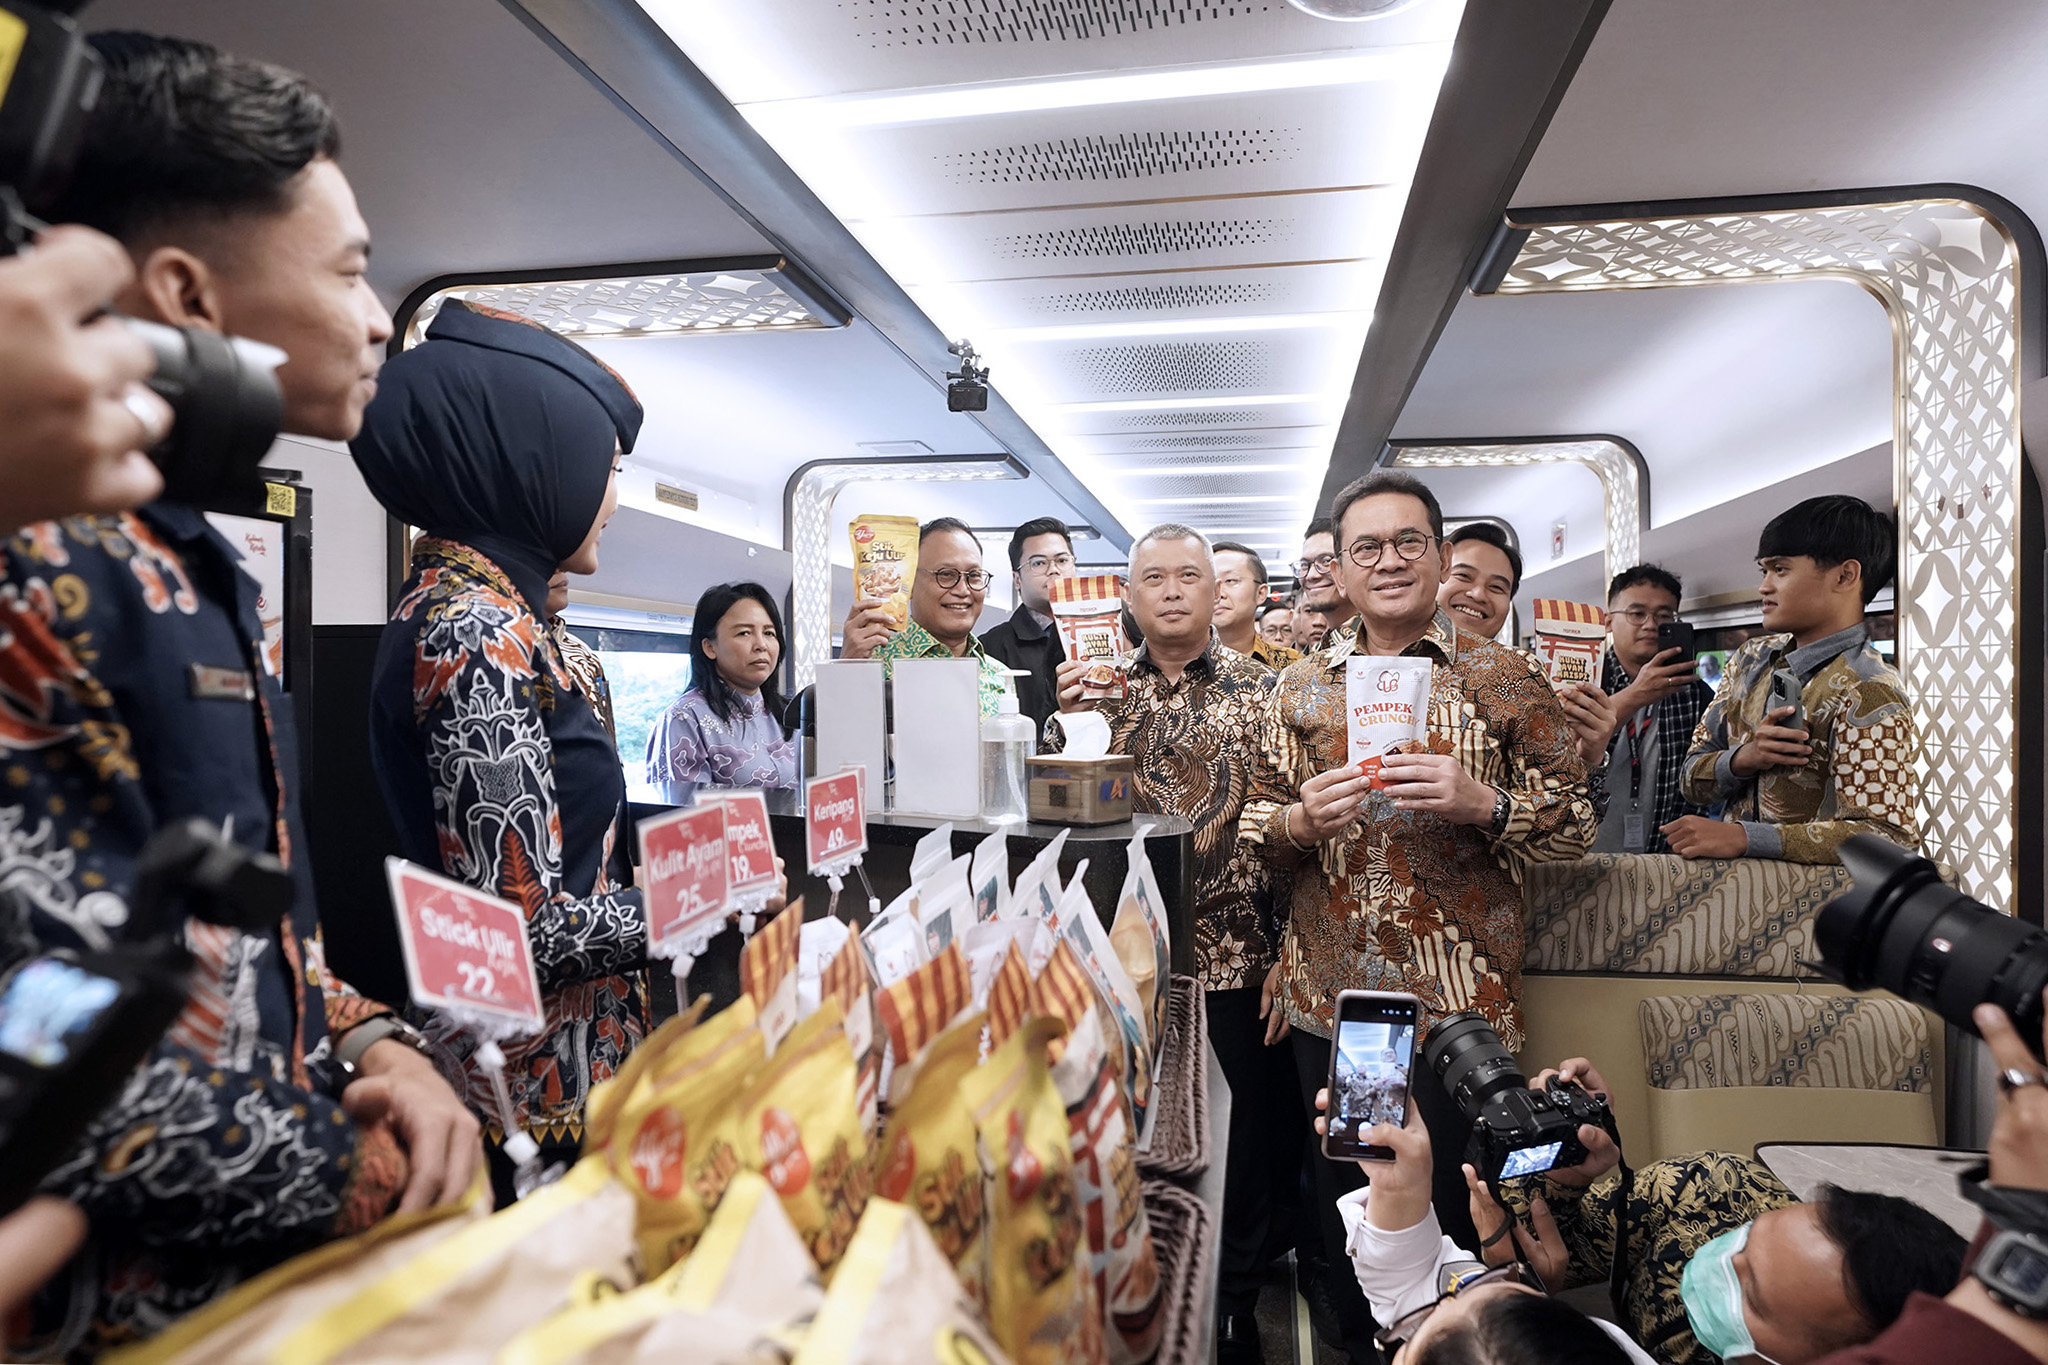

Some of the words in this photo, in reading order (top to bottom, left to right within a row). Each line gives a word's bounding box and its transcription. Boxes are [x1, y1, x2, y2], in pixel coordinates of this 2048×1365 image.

[872, 541, 894, 551] Stik
[1559, 655, 1587, 665] KULIT
[1561, 664, 1586, 673] AYAM
[1557, 671, 1590, 682] KRISPI
[1353, 703, 1413, 717] PEMPEK
[1359, 713, 1420, 727] CRUNCHY
[727, 818, 762, 844] mpek
[827, 827, 844, 849] 49
[649, 848, 685, 885] Kulit
[686, 837, 723, 870] Ayam
[731, 855, 750, 883] 19
[677, 883, 701, 920] 25
[420, 906, 481, 950] Stick
[457, 961, 495, 997] 22
